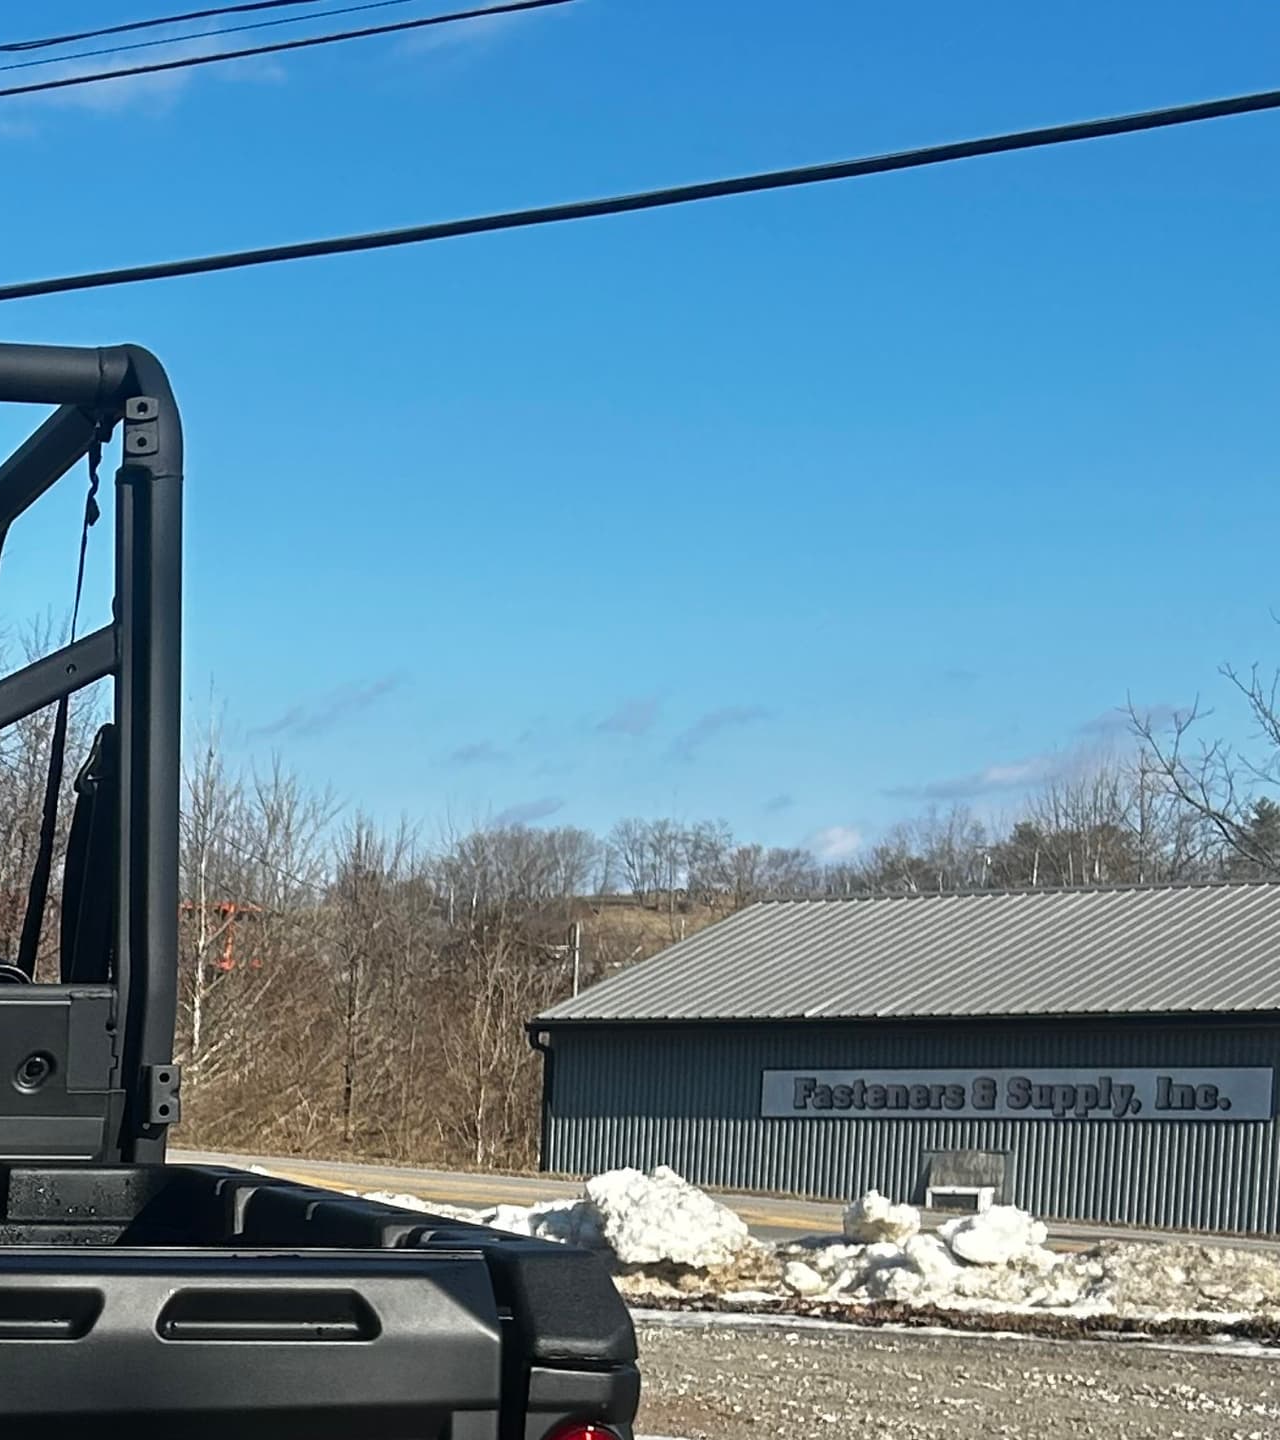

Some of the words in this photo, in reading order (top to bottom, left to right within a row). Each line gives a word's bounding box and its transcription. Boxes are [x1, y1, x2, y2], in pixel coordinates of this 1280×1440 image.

[793, 1077, 966, 1110] Fasteners
[972, 1077, 997, 1110] &
[1006, 1076, 1142, 1118] Supply,
[1155, 1076, 1232, 1111] Inc.
